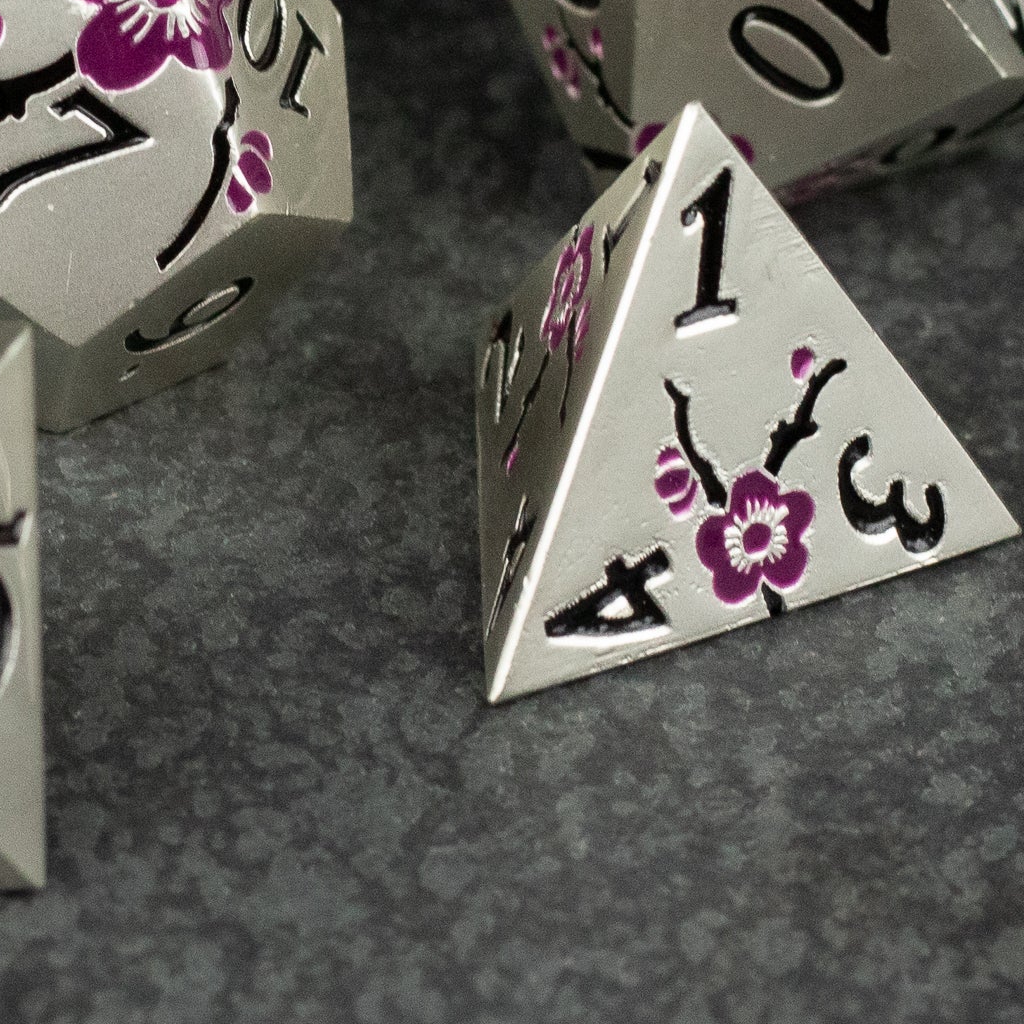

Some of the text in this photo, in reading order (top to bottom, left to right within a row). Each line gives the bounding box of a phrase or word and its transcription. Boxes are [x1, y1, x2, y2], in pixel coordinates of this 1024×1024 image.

[673, 166, 739, 337] 1
[837, 431, 946, 554] 3
[544, 541, 672, 644] 4
